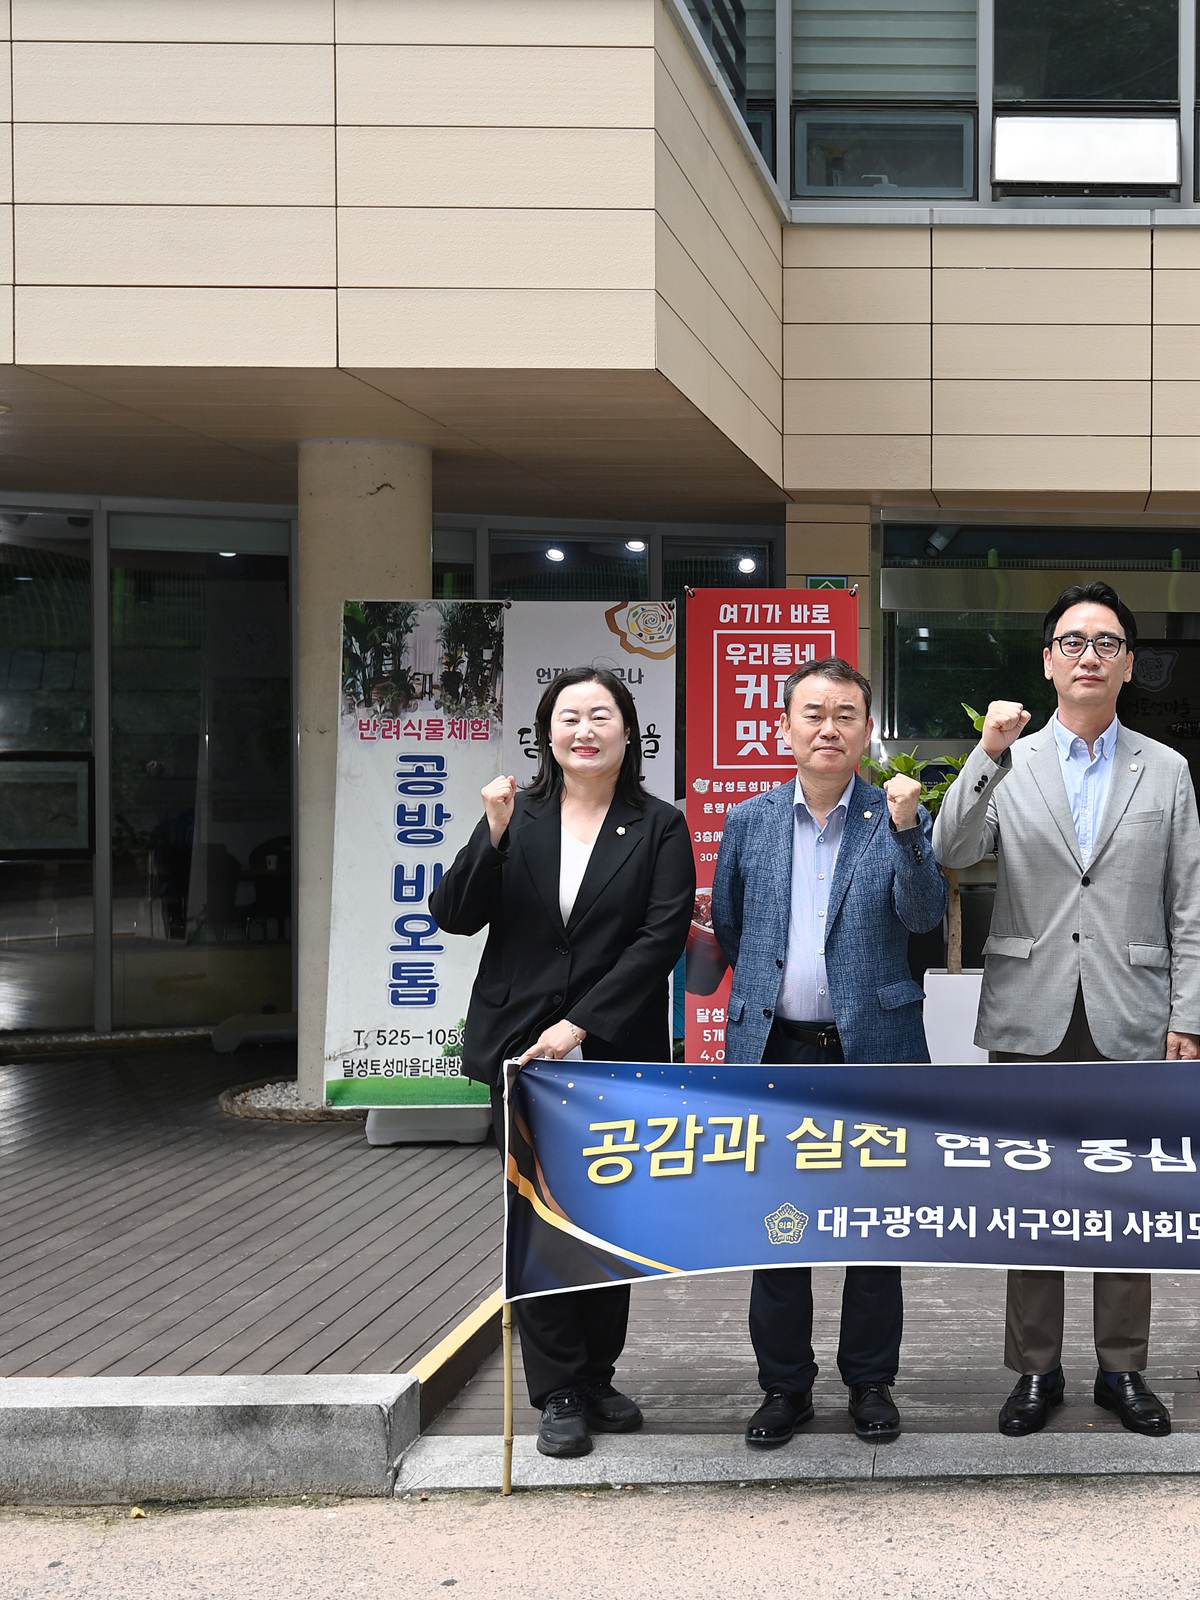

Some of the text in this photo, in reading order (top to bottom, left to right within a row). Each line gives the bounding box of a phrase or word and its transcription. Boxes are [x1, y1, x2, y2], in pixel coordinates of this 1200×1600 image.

[719, 604, 831, 623] 여기가 바로
[725, 643, 816, 665] 우리동네
[358, 718, 491, 741] 반려식물체험
[395, 753, 452, 845] 공방
[696, 1008, 729, 1023] 달성
[700, 1049, 726, 1063] 4,0
[342, 1057, 462, 1078] 달성토성마을다락방
[582, 1114, 766, 1185] 공감과
[785, 1117, 907, 1170] 실천
[934, 1131, 1056, 1172] 현장
[817, 1205, 977, 1239] 대구광역시
[986, 1206, 1112, 1243] 서구의회
